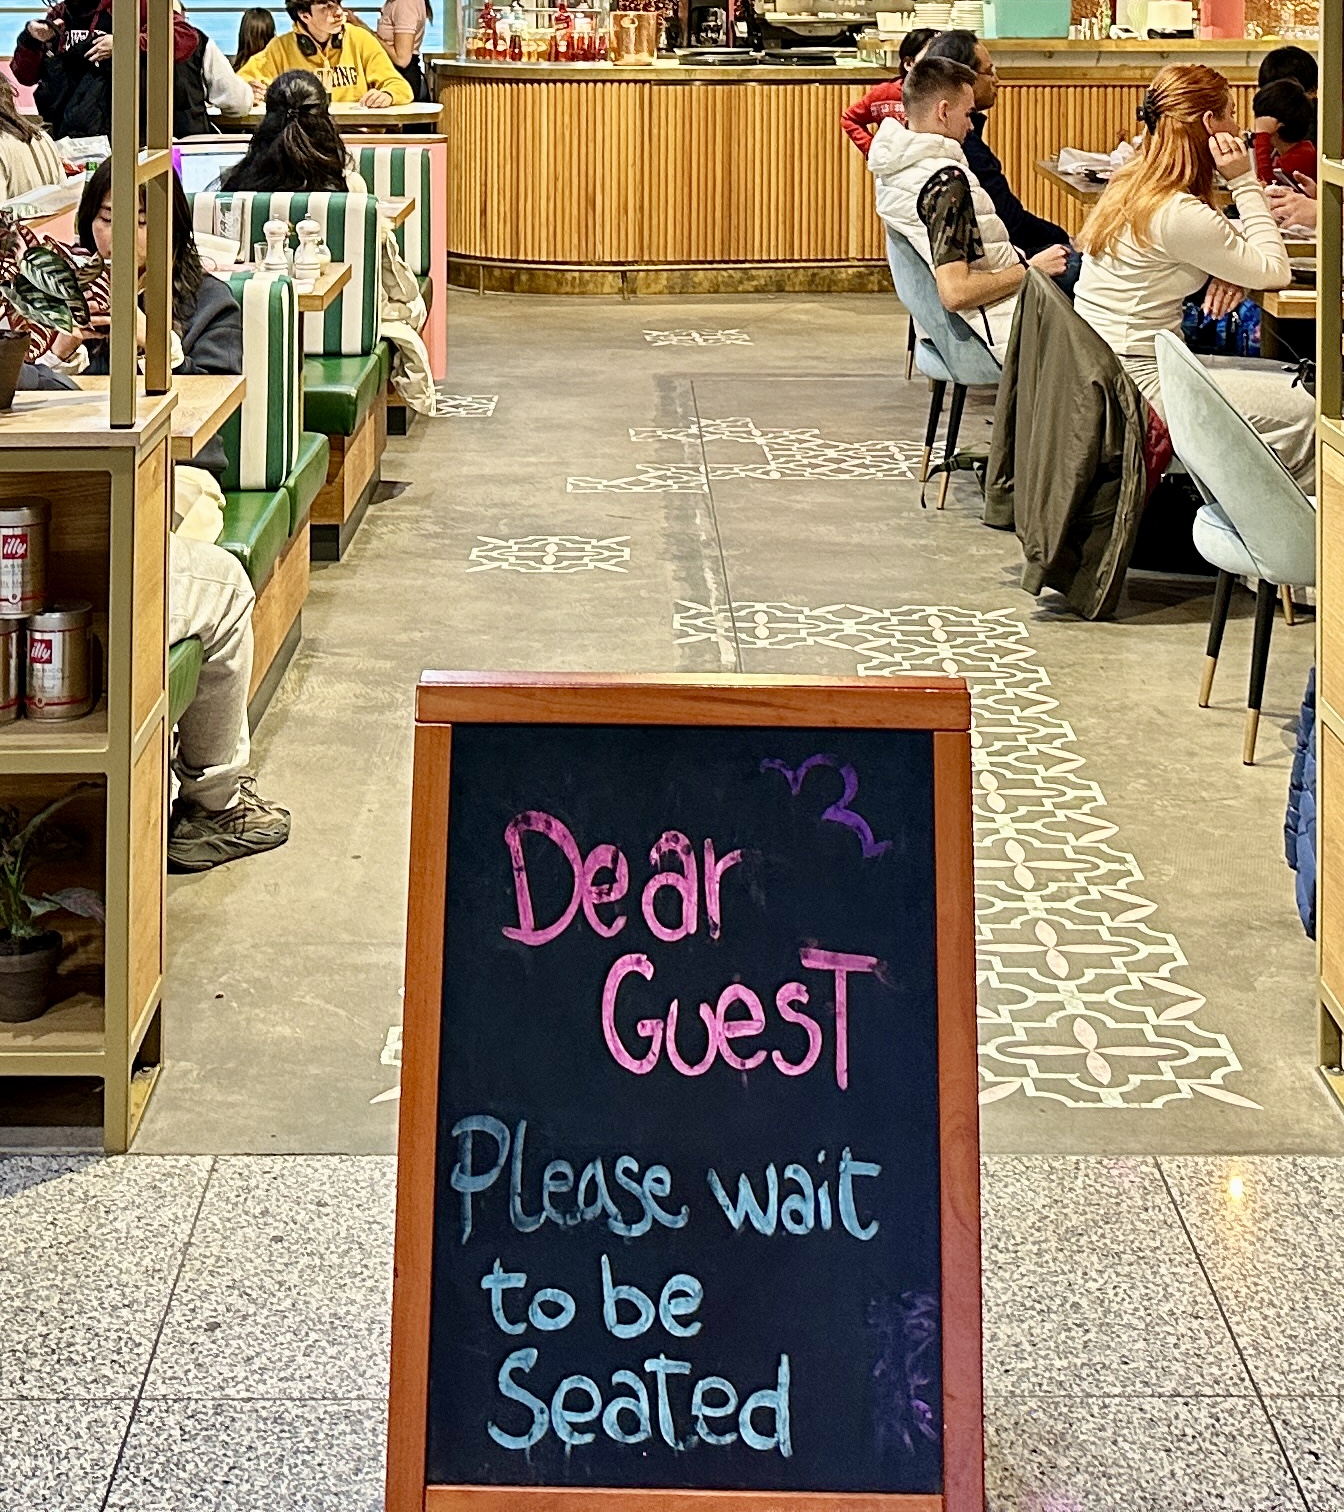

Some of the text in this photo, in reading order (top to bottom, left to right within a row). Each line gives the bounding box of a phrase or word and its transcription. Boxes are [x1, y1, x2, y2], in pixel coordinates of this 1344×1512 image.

[3, 538, 27, 558] illy
[31, 641, 51, 662] illy
[500, 809, 744, 947] Dear
[450, 1114, 883, 1246] Please wait
[480, 1254, 704, 1339] to be
